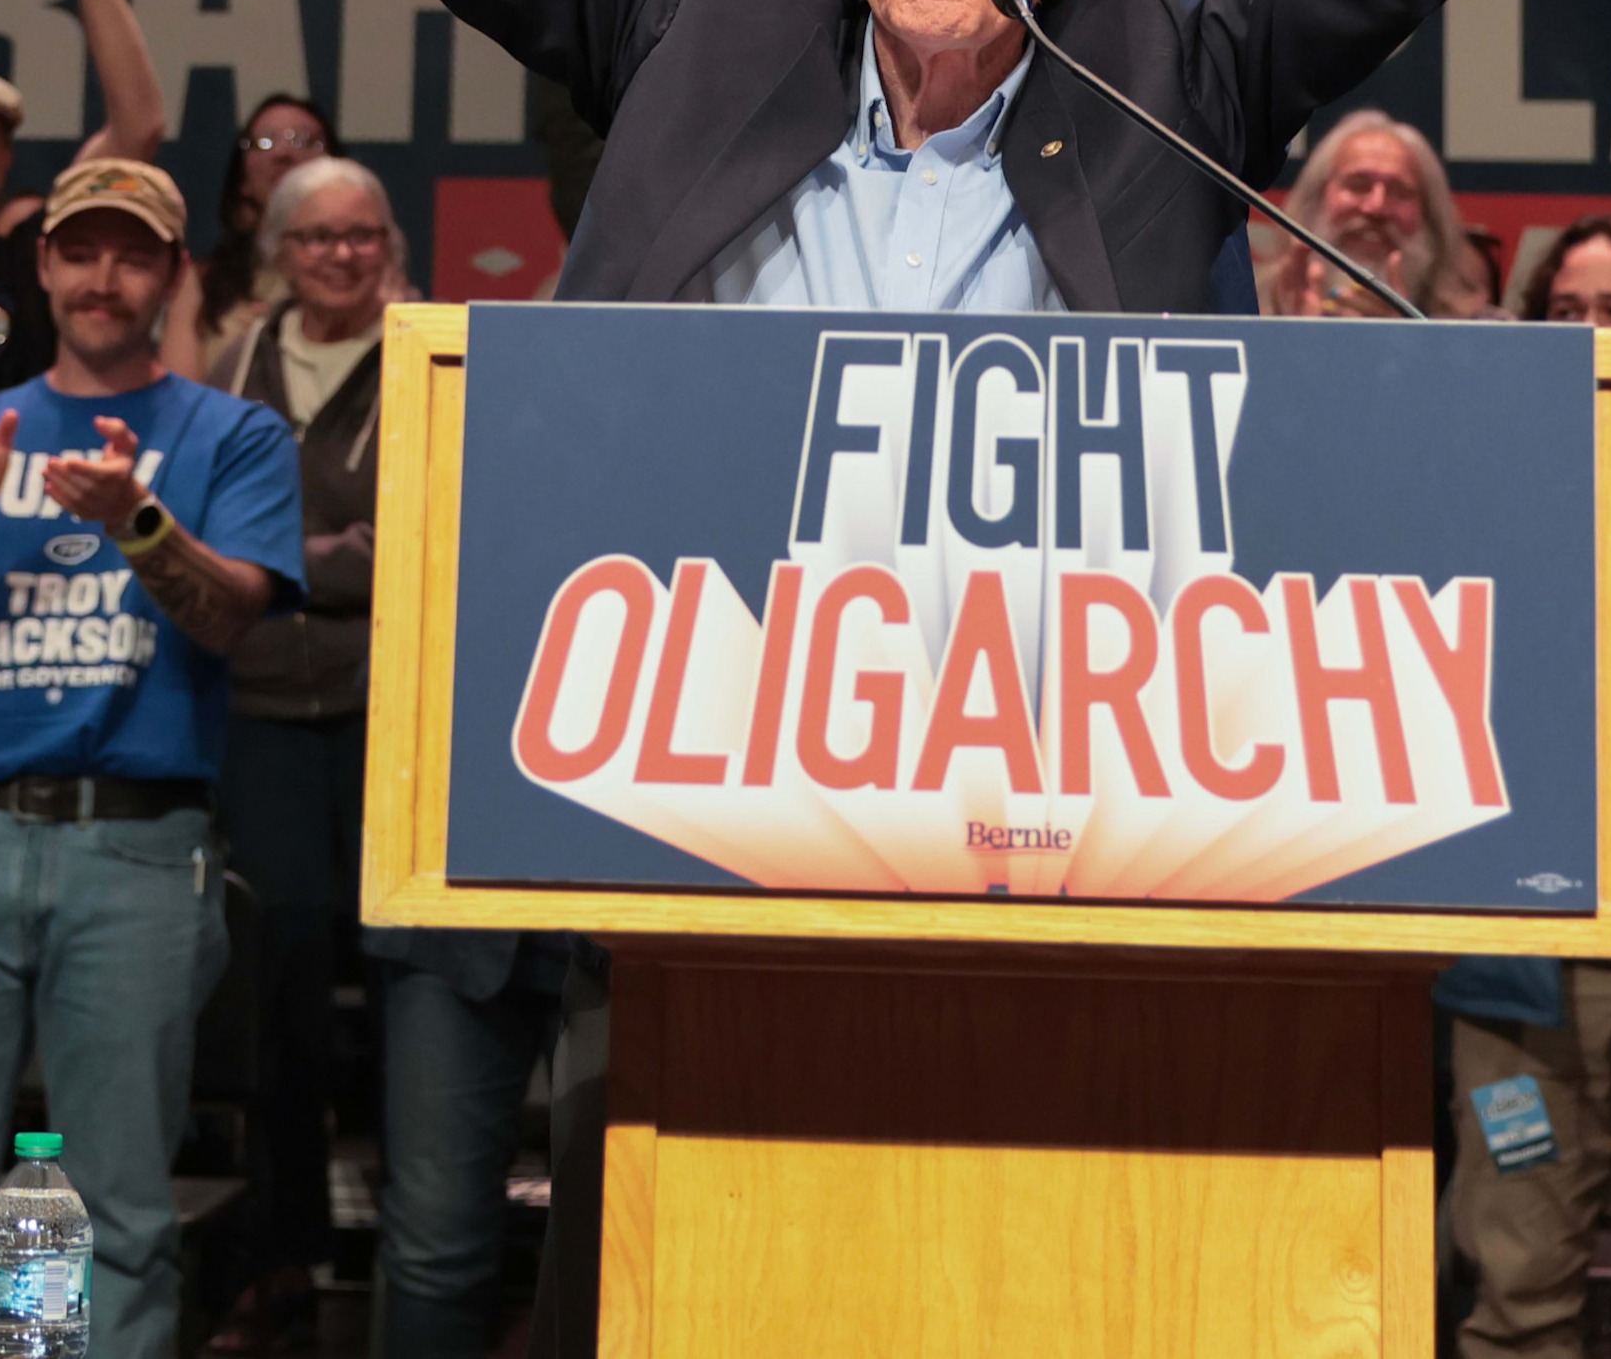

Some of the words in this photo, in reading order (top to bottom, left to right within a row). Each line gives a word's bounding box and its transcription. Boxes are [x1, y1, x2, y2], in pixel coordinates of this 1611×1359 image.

[791, 332, 1248, 554] FIGHT
[5, 568, 134, 617] TROY
[512, 553, 1510, 811] OLIGARCHY
[965, 820, 1073, 850] Bernie
